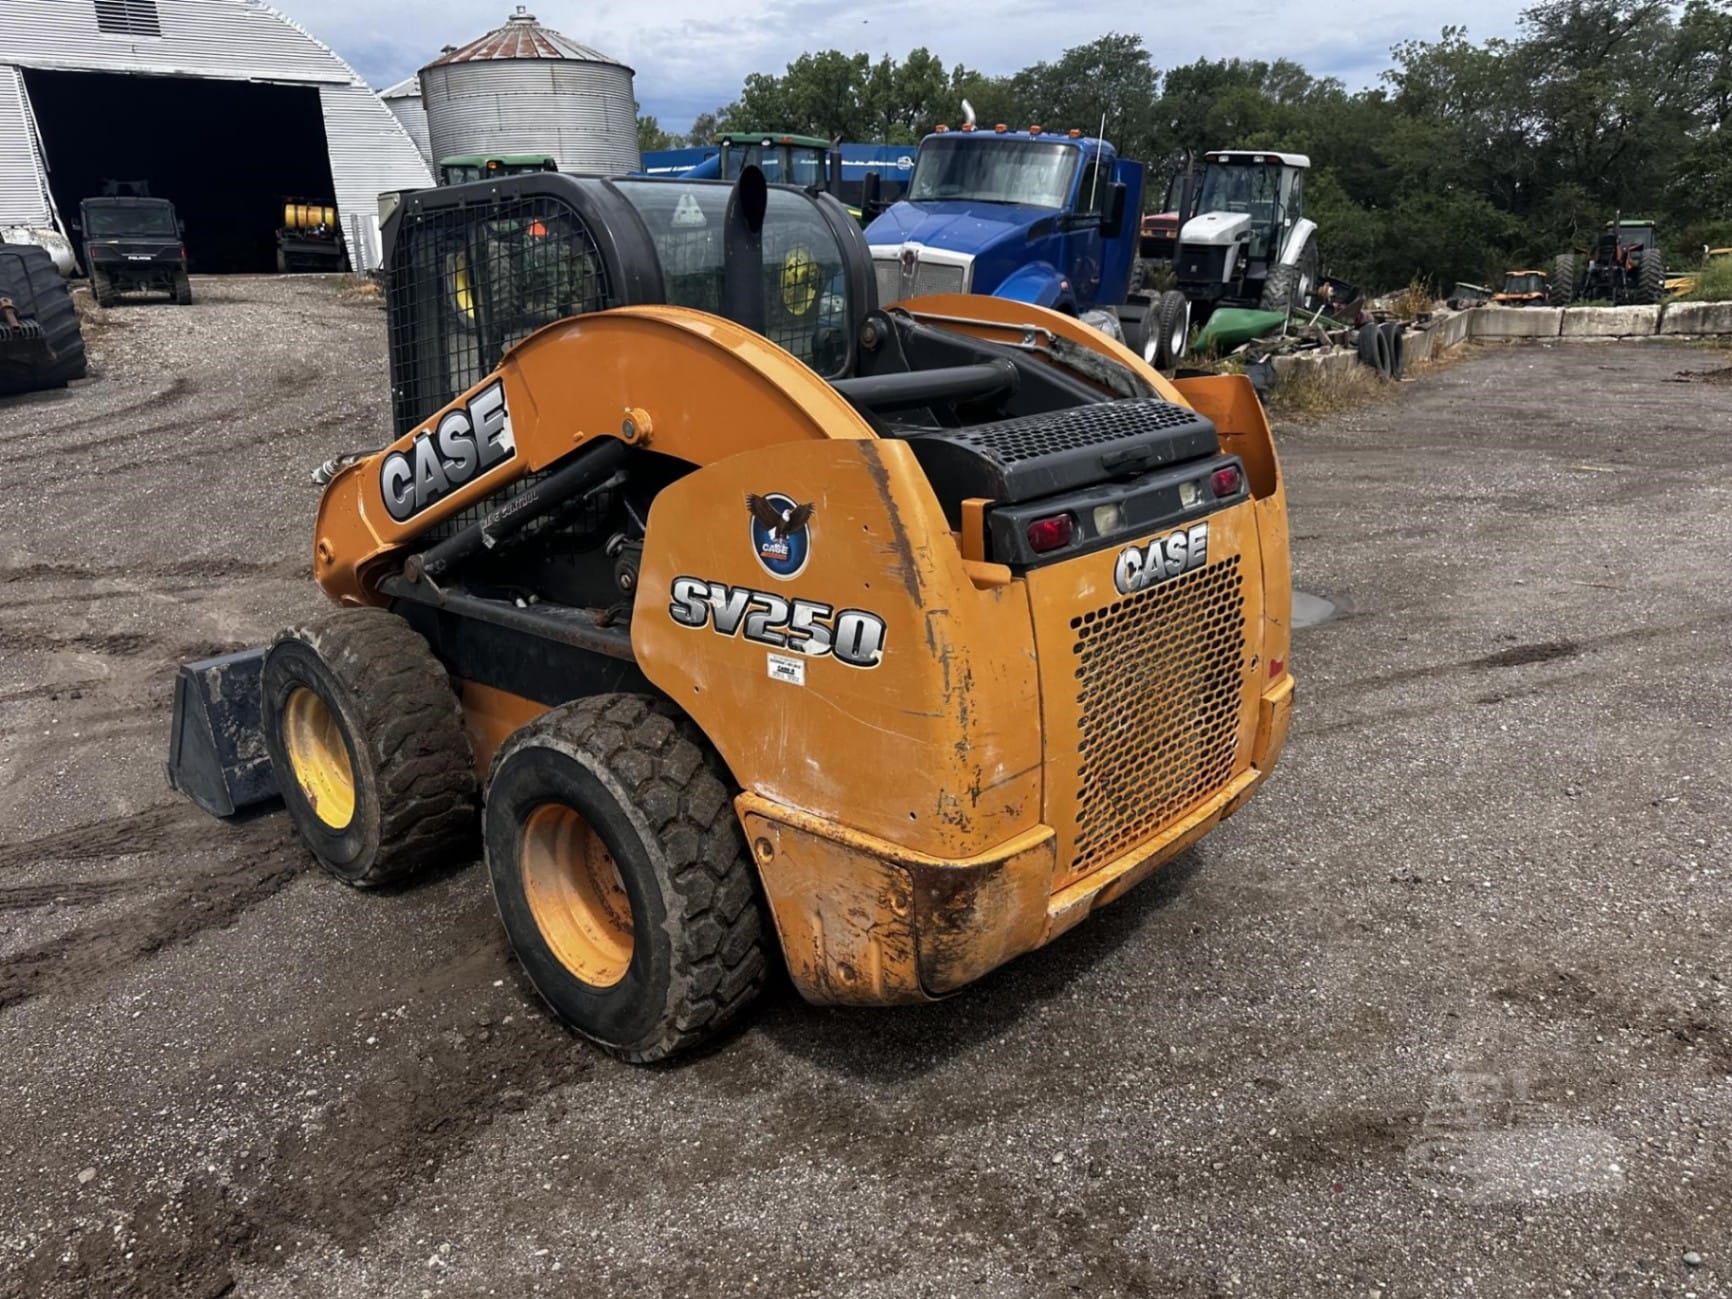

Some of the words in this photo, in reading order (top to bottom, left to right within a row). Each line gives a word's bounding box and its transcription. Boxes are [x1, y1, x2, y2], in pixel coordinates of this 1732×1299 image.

[380, 377, 515, 520] CASE
[1114, 521, 1208, 596] CASE
[669, 576, 887, 668] SV250
